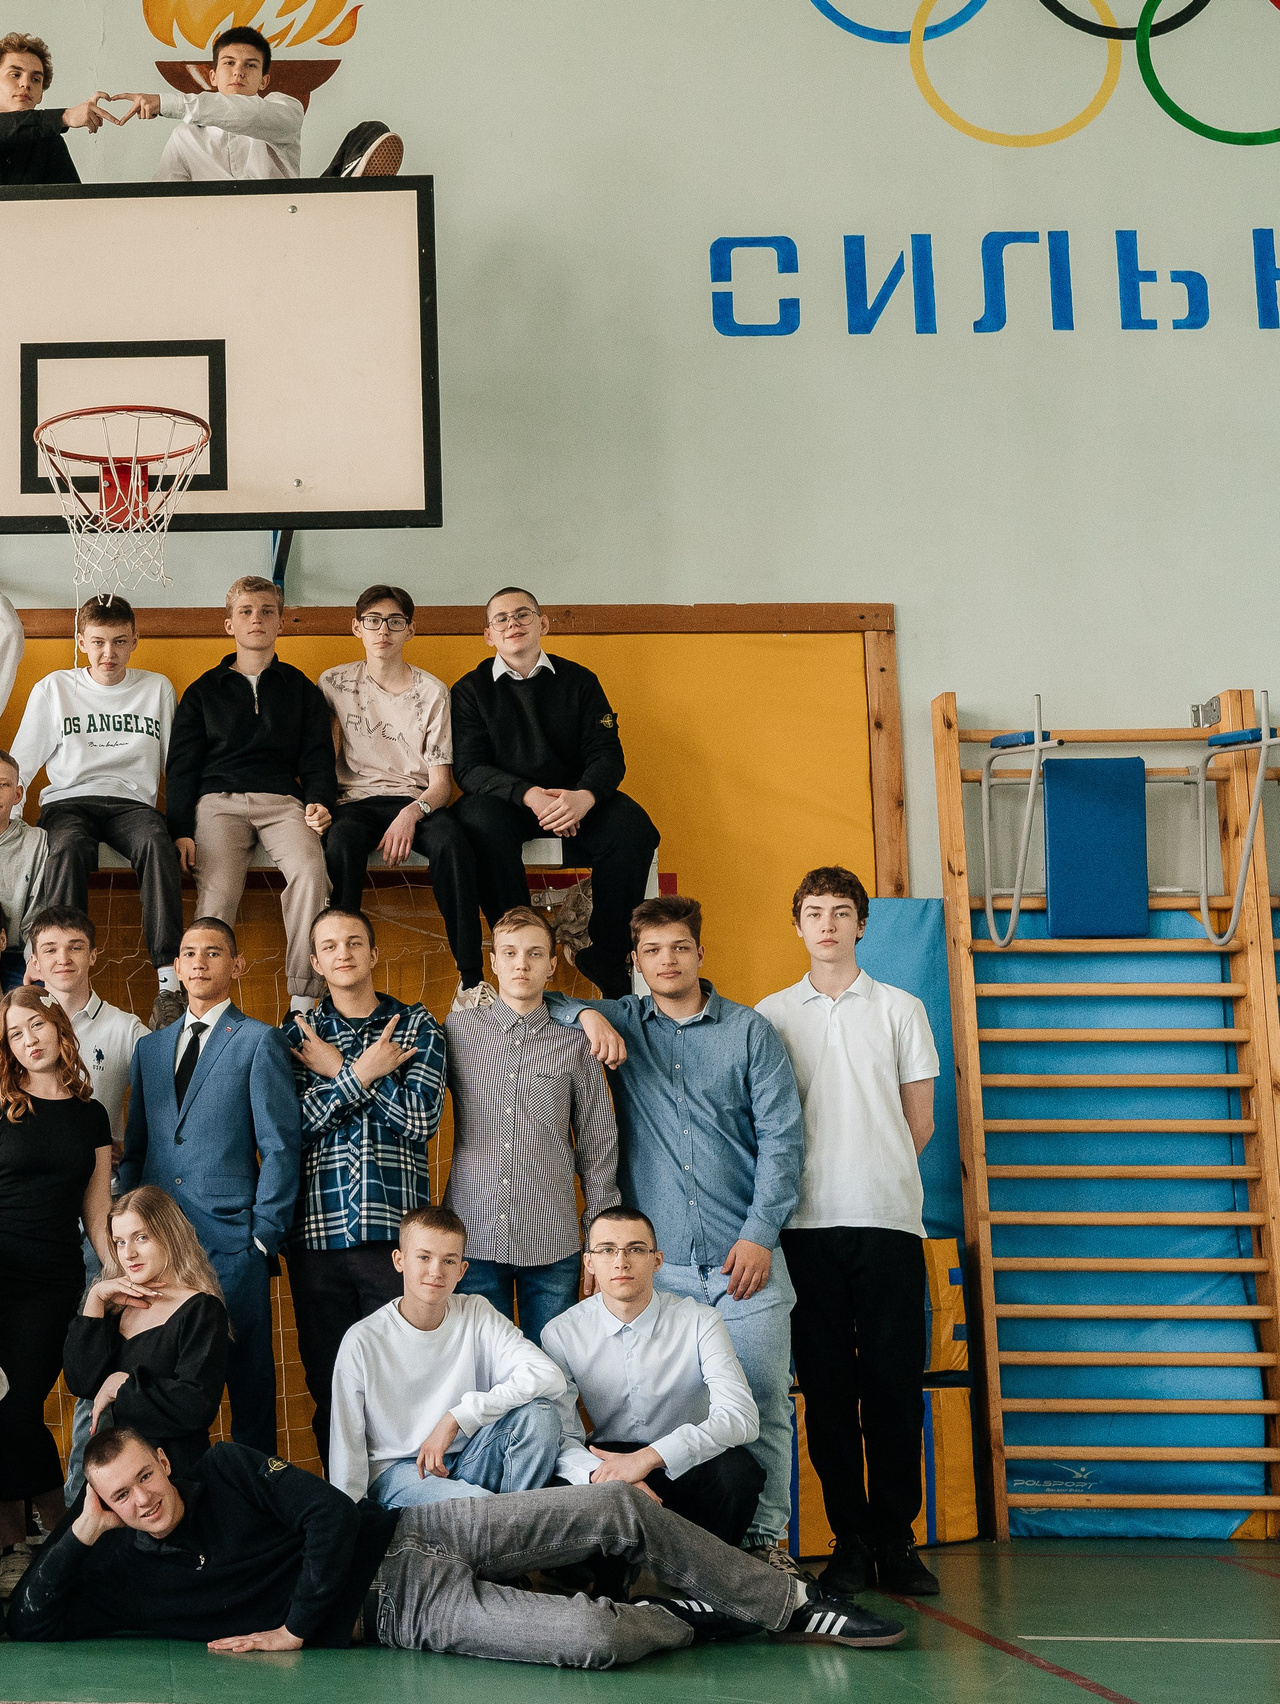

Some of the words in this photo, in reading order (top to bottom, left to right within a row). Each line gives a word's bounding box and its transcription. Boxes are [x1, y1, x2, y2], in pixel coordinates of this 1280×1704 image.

[61, 716, 81, 738] OS
[86, 713, 161, 741] ANGELES
[1013, 1479, 1098, 1490] POLSPORT
